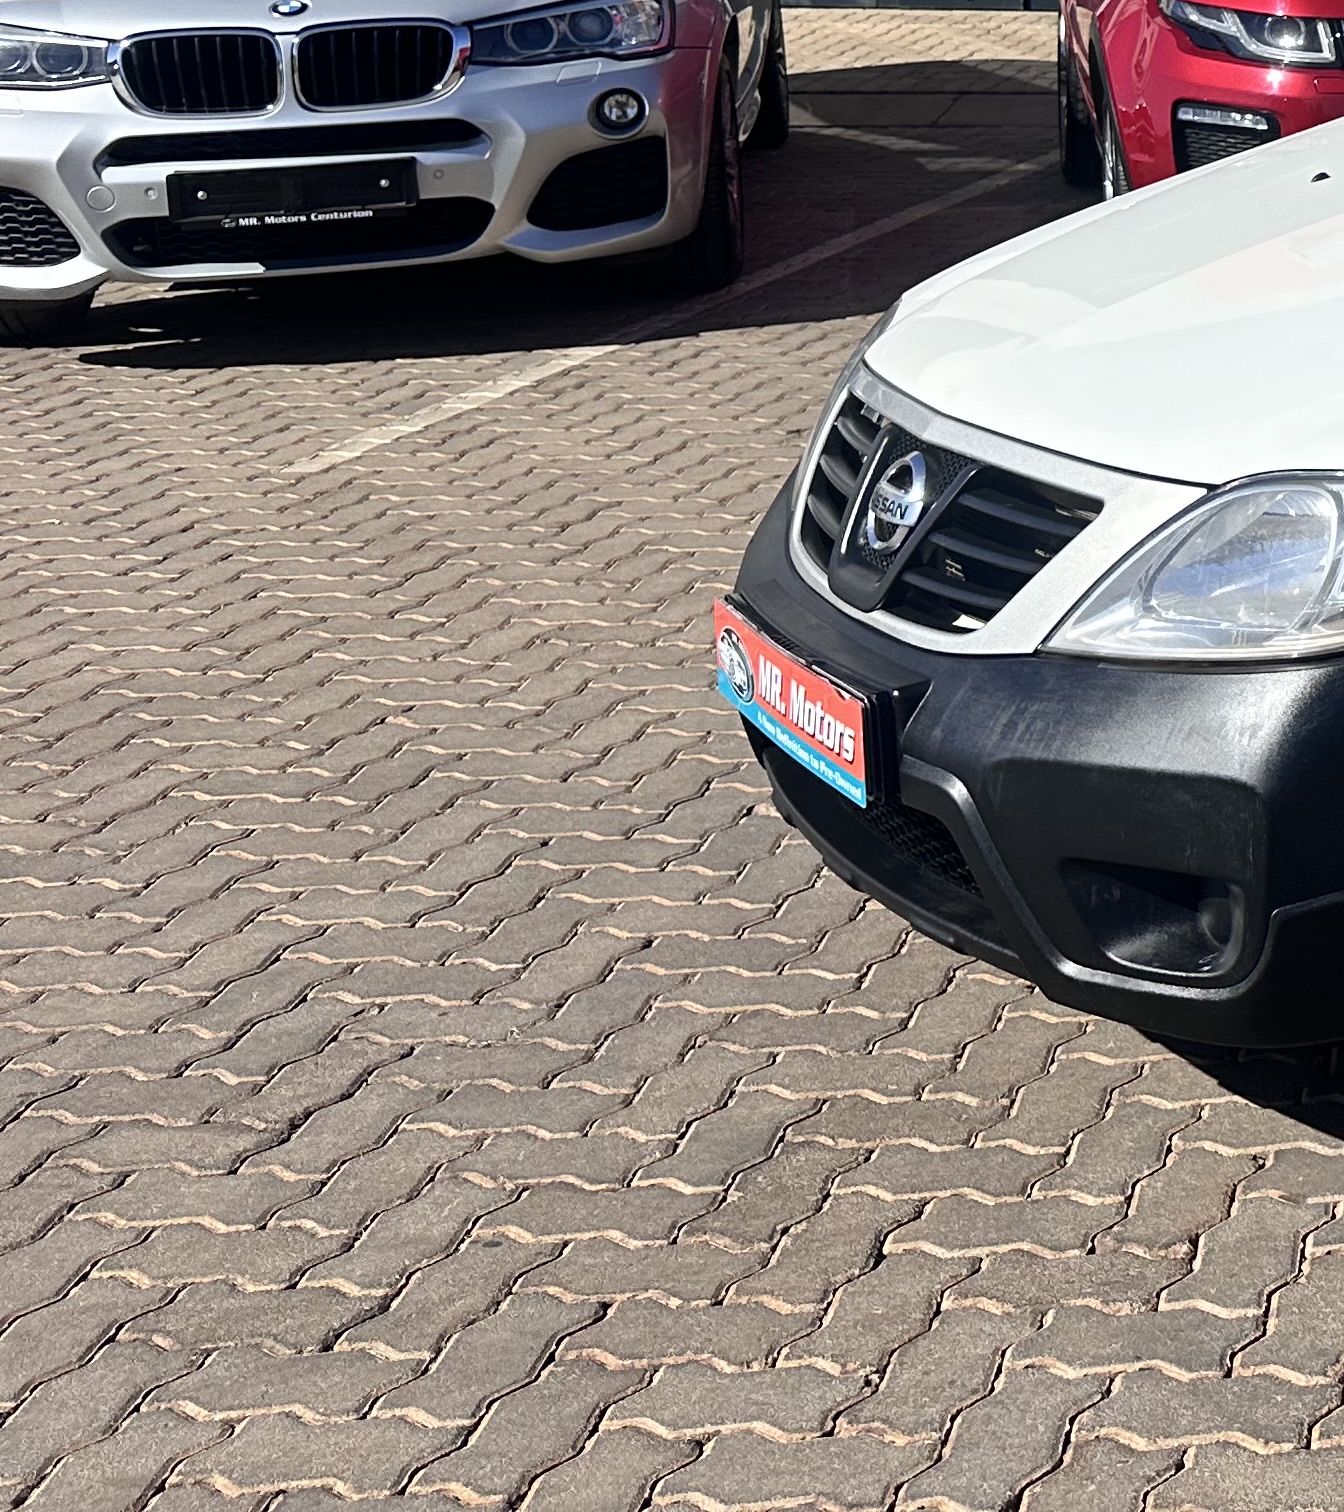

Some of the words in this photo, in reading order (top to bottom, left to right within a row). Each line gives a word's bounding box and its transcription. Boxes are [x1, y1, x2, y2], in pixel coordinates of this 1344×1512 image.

[238, 217, 261, 227] MR.
[264, 215, 307, 225] Motors
[310, 210, 374, 222] Centurion
[758, 654, 786, 715] MR.
[789, 680, 856, 762] Motors
[810, 755, 819, 769] to
